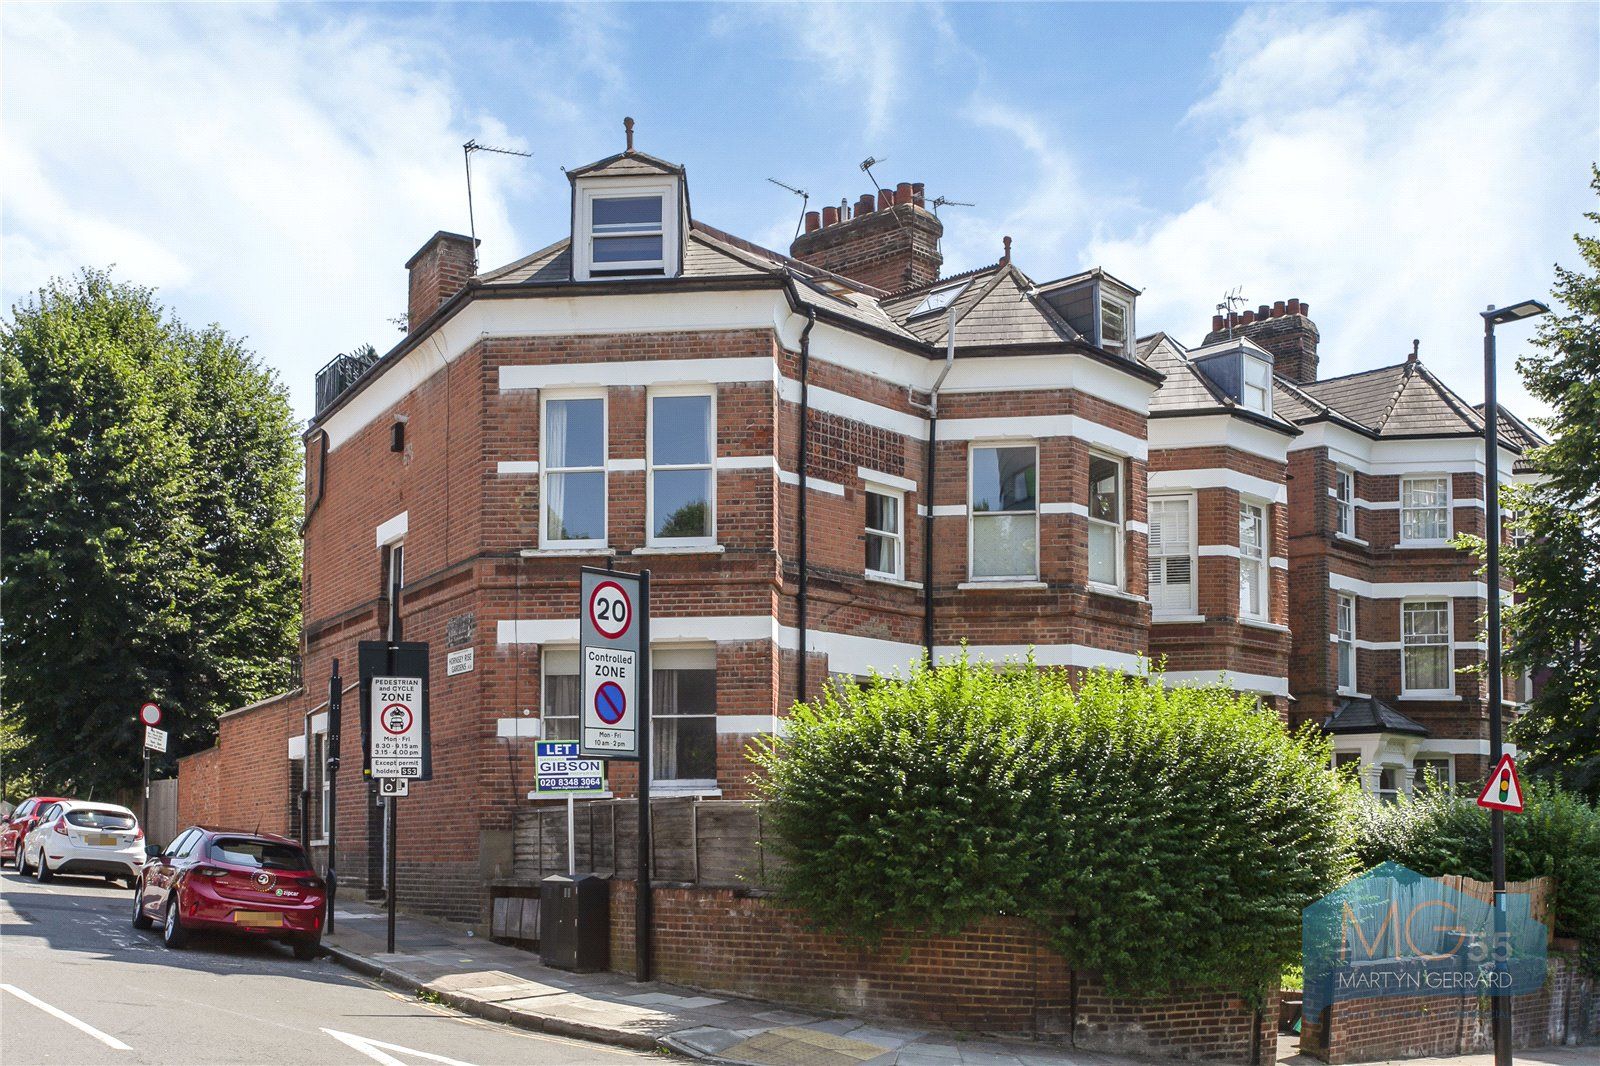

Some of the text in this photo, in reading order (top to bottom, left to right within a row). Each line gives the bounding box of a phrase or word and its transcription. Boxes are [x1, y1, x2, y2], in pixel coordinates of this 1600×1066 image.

[597, 598, 626, 622] 20
[588, 652, 632, 664] Controlled
[595, 665, 626, 678] ZONE
[381, 693, 412, 701] ZONE
[546, 744, 572, 754] LET
[540, 762, 600, 771] GIBSON
